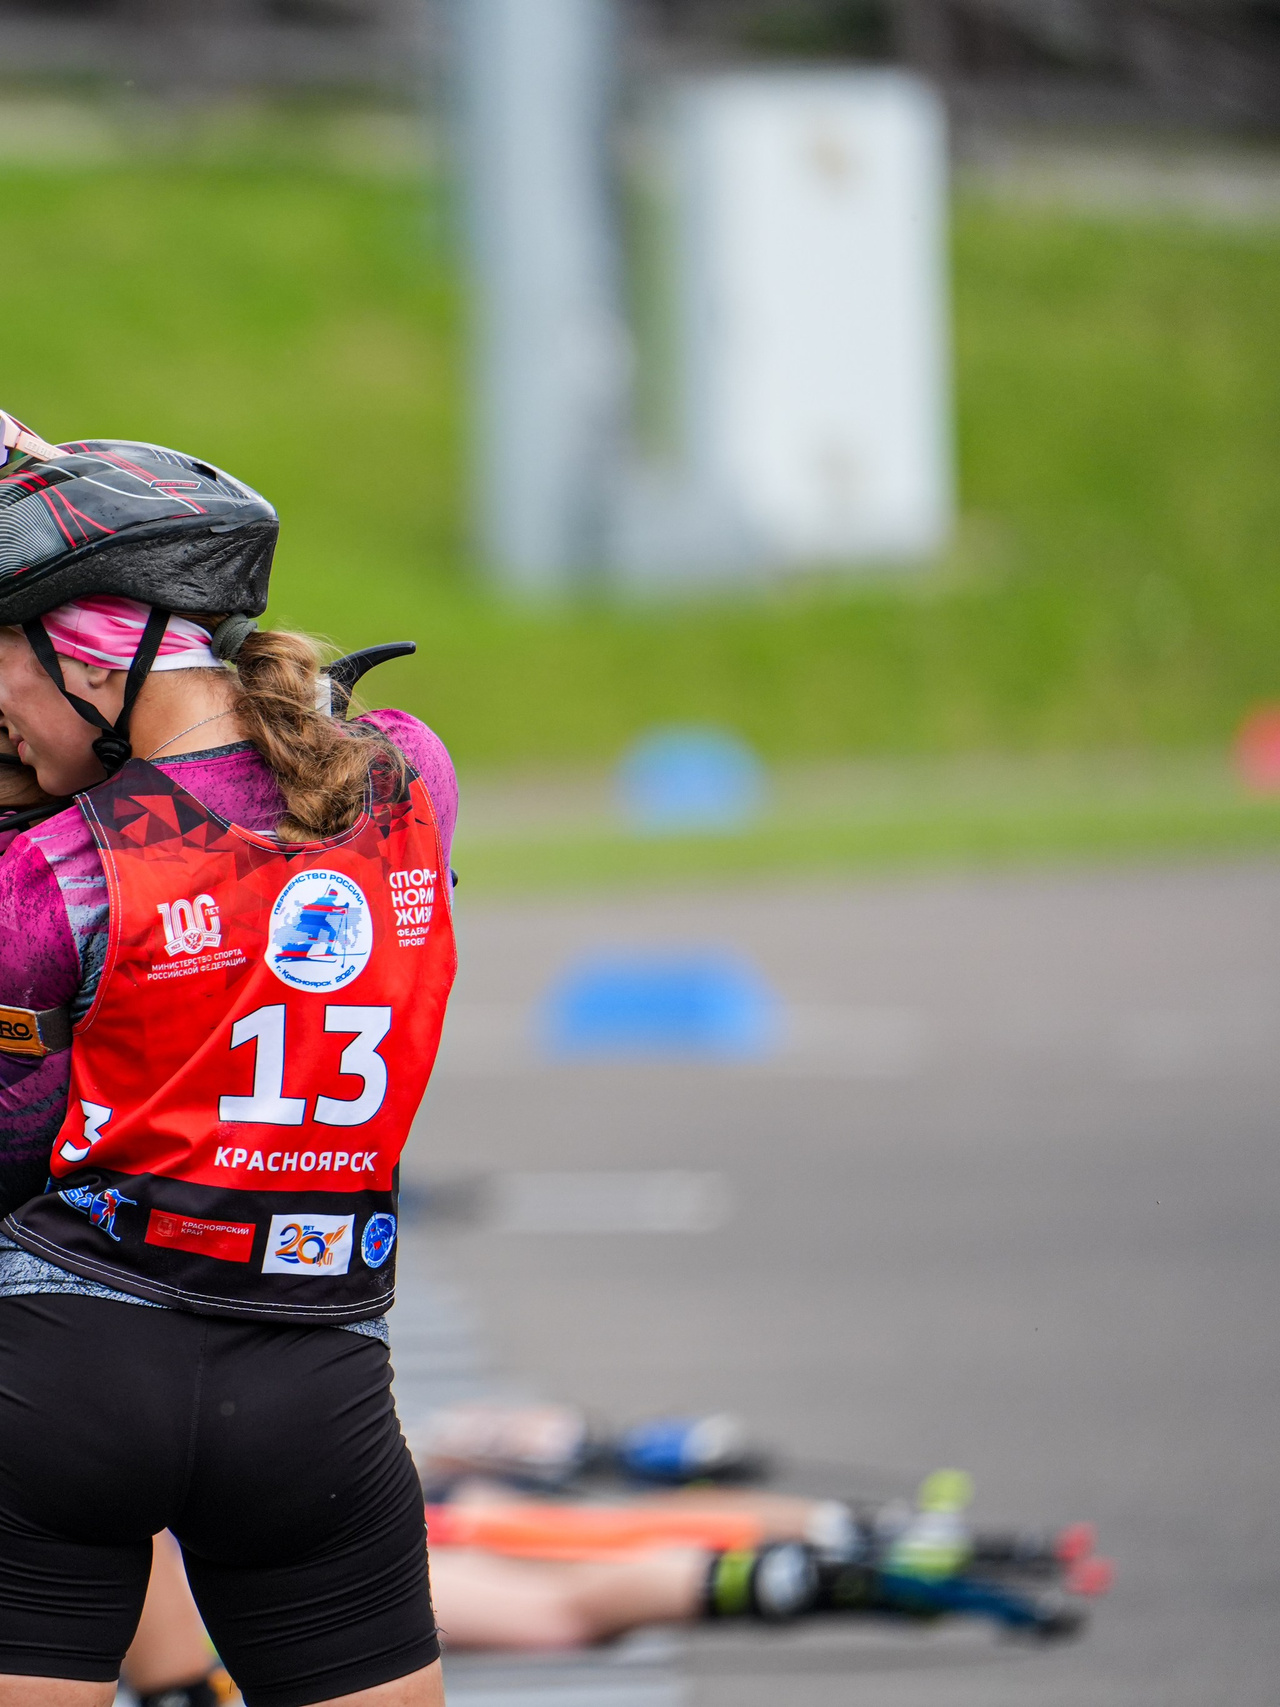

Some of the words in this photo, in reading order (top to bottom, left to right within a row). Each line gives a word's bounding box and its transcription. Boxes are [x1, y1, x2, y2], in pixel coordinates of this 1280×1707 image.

[273, 872, 327, 915] ПЕРВЕНСТВО
[329, 873, 364, 905] РОССИИ
[204, 906, 220, 916] ЛЕТ
[147, 965, 199, 981] РОССИЙСКОЙ
[199, 956, 247, 972] ФЕДЕРАЦИИ
[151, 954, 212, 972] МИНИСТЕРСТВО
[213, 948, 243, 960] СПОРТА
[281, 969, 332, 988] Красноярск
[334, 964, 356, 983] 2023
[218, 1003, 392, 1127] 13
[214, 1146, 378, 1172] КРАСНОЯРСК
[180, 1227, 203, 1236] КРАЙ
[181, 1220, 250, 1236] КРАСНОЯРСКИЙ
[275, 1223, 326, 1265] 20
